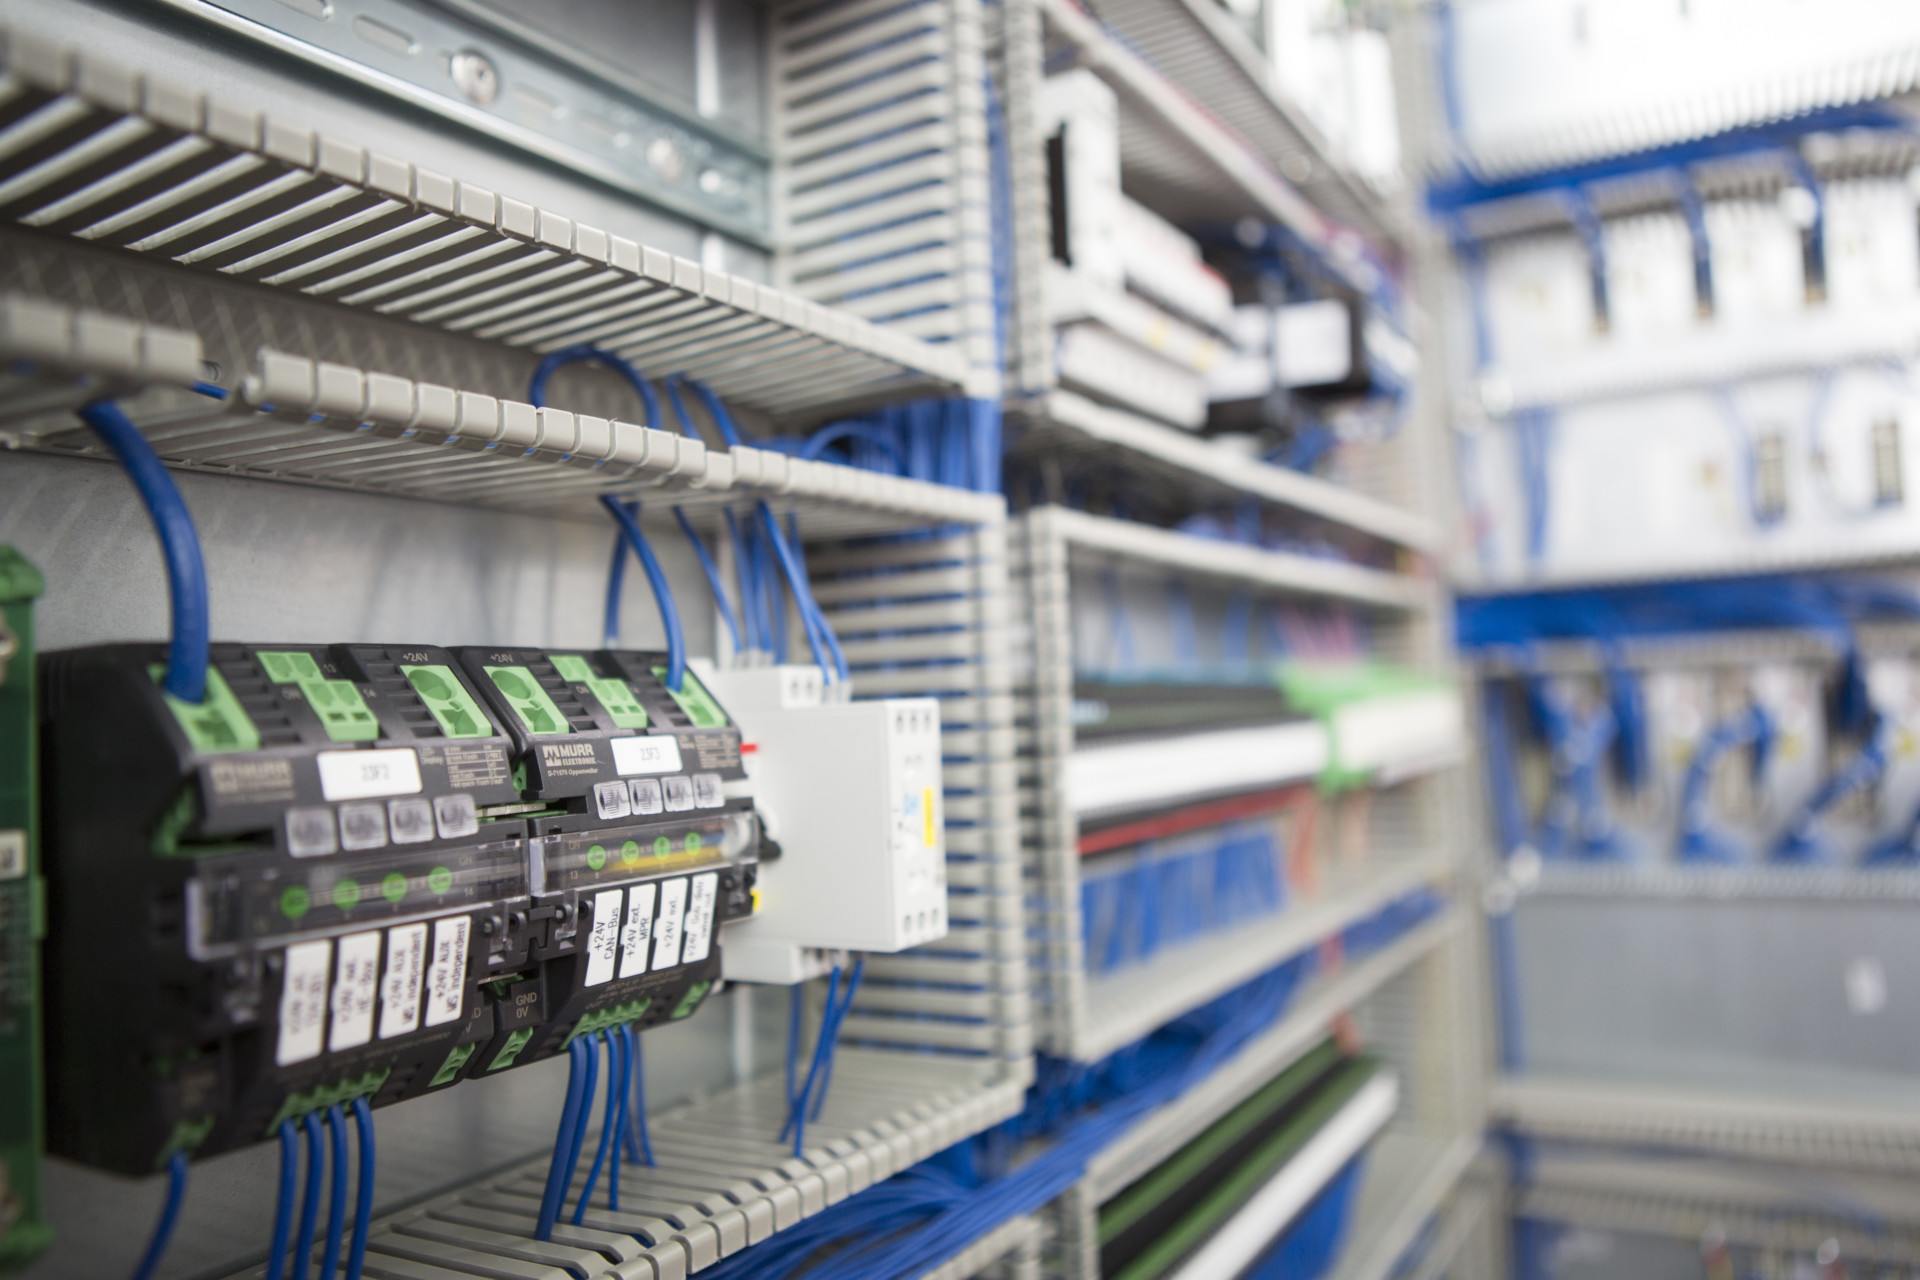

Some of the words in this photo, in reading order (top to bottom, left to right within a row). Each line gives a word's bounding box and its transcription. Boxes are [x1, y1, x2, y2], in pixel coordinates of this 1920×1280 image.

[403, 652, 428, 662] +24V
[490, 653, 514, 663] +24V
[559, 744, 594, 757] MURR
[594, 922, 605, 951] +24V
[604, 907, 619, 960] CAN-Bus
[626, 928, 636, 958] +24V
[631, 904, 640, 924] ext.
[639, 917, 650, 941] MPR
[664, 920, 674, 948] +24V
[394, 949, 406, 973] AUX
[440, 940, 450, 963] AUX
[450, 922, 467, 991] independent
[407, 931, 422, 1002] independent
[390, 979, 402, 1009] +24V
[436, 969, 447, 998] +24V
[446, 994, 460, 1014] WS
[516, 992, 537, 1006] GND
